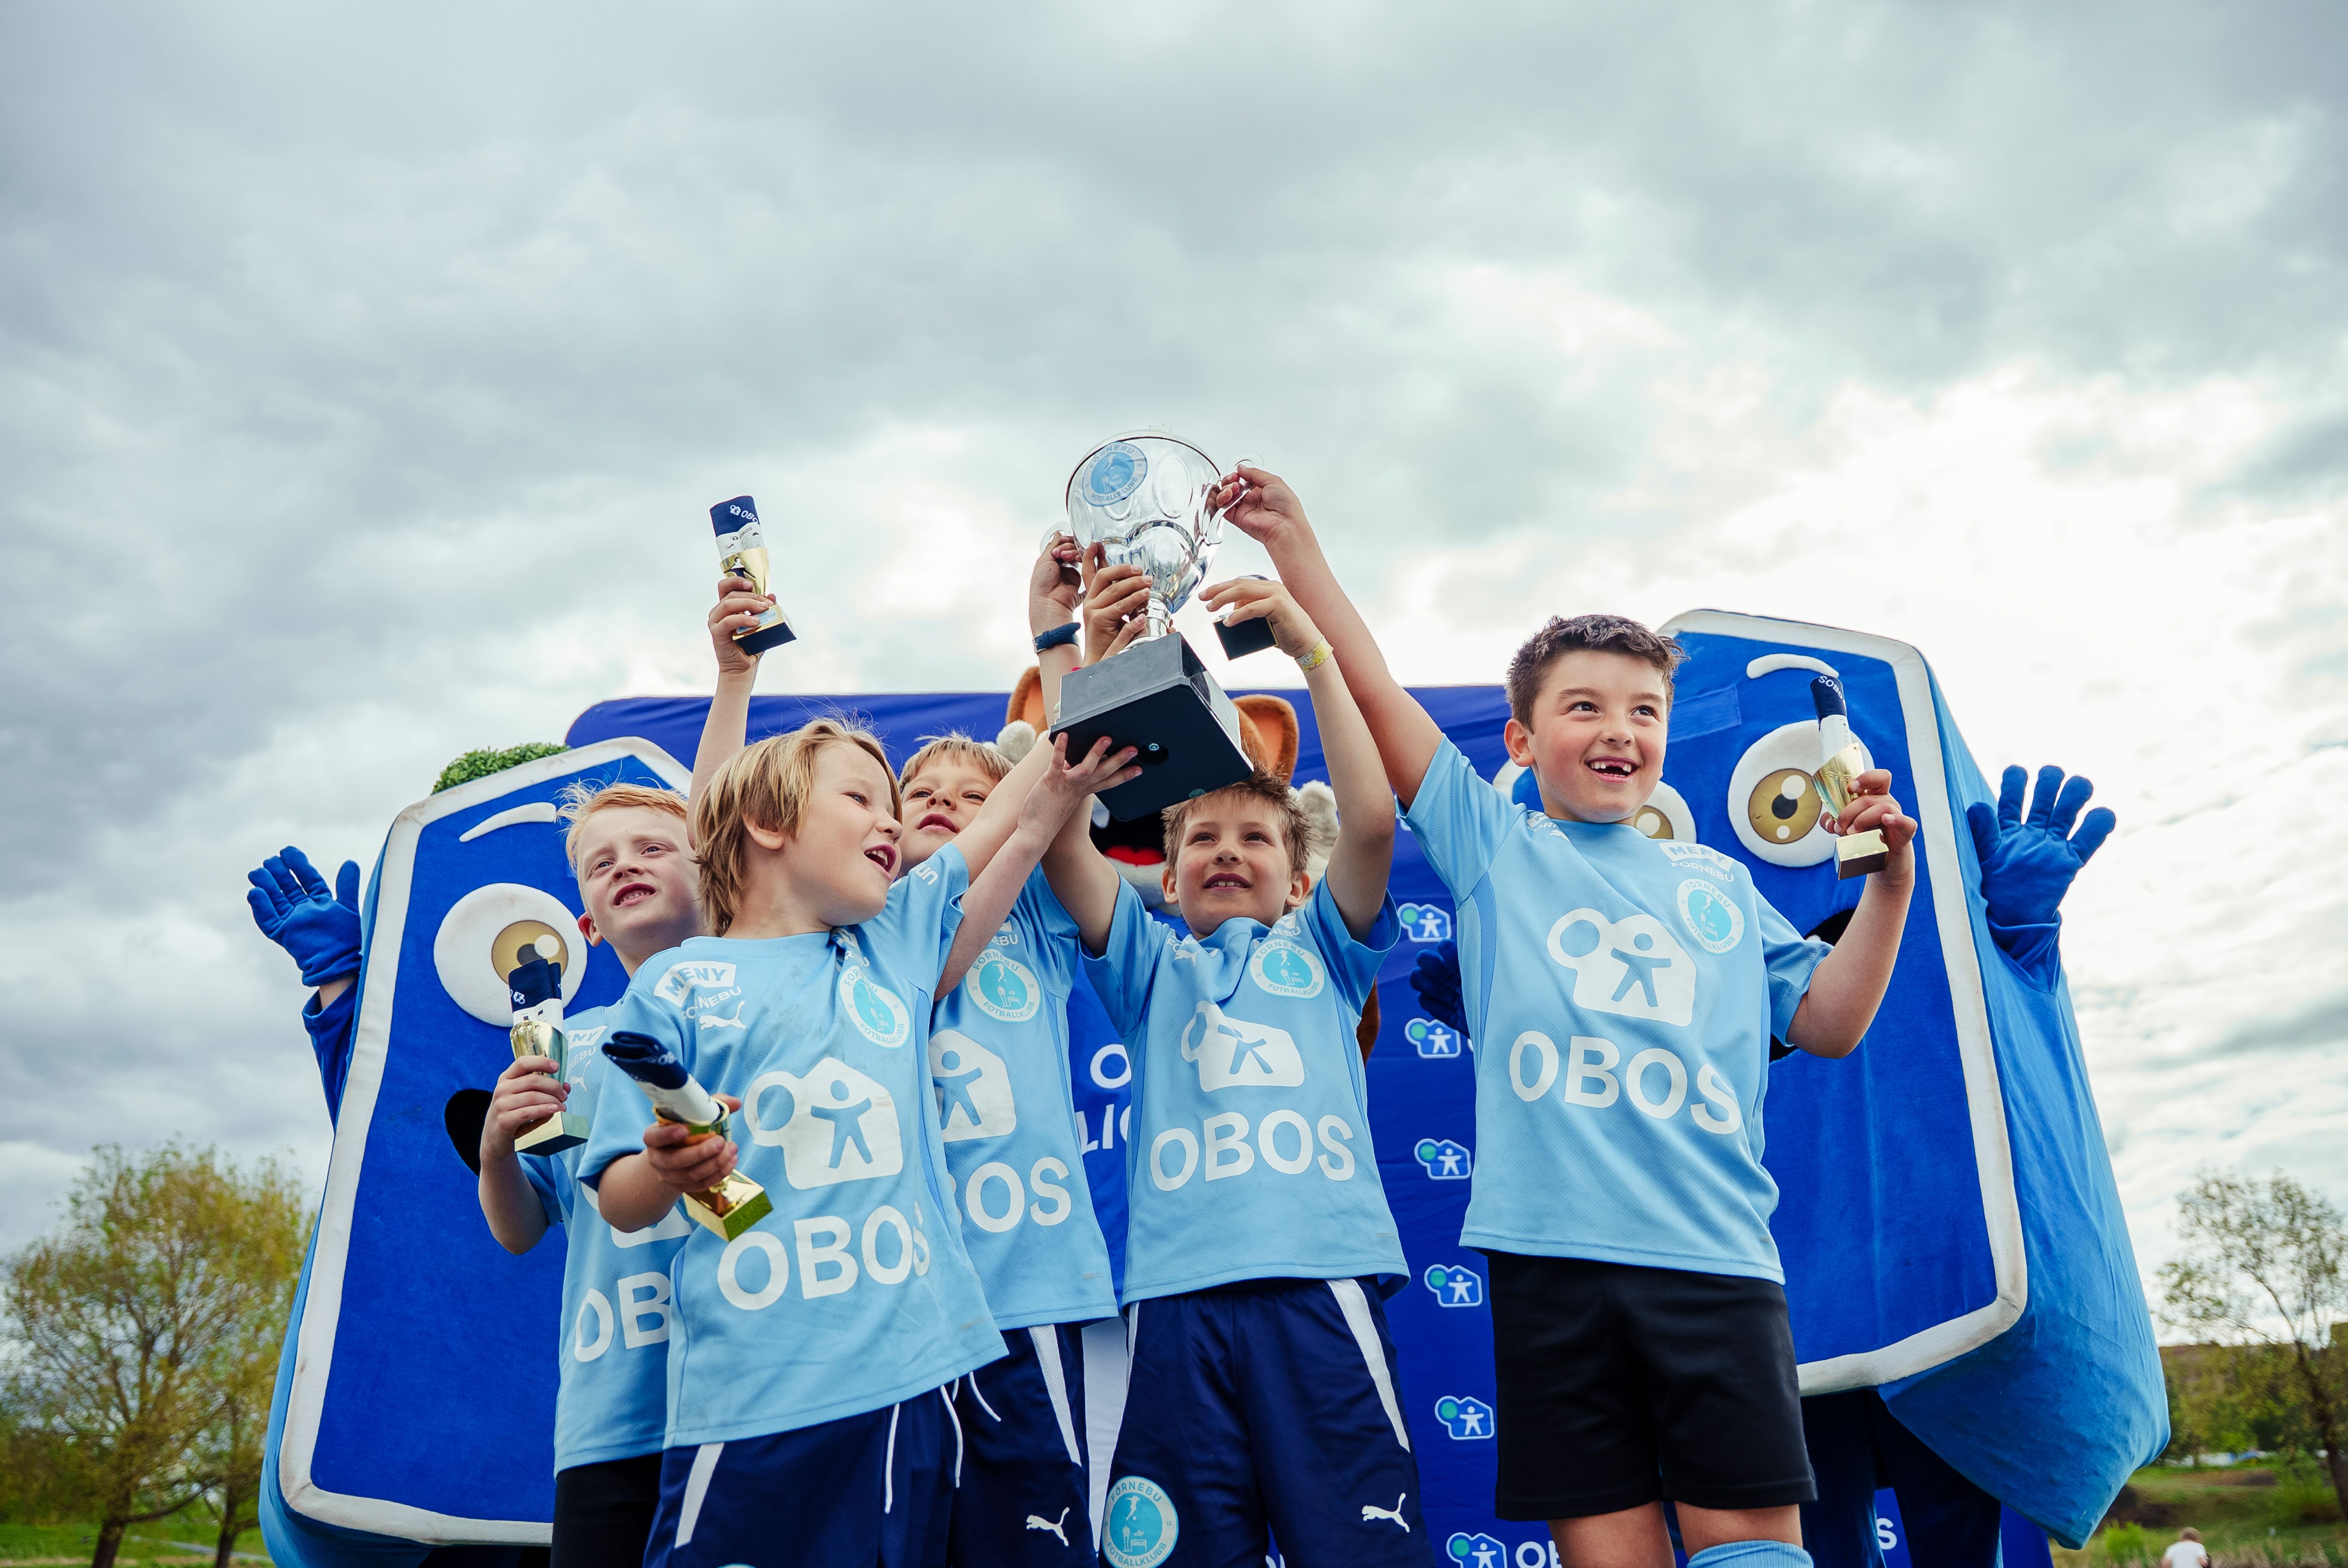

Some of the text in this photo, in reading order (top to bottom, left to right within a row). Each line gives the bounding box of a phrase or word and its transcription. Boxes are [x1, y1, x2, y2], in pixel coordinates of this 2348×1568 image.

[1089, 445, 1135, 469] FORNEBU
[1091, 477, 1138, 502] FOTBALLKLUBB
[741, 510, 759, 524] OBO
[1818, 676, 1843, 699] OBOS
[1668, 846, 1727, 863] MENY
[1670, 861, 1734, 883] FORNEBU
[1685, 881, 1731, 908] FORNEBU
[1269, 926, 1301, 937] NEBU
[1687, 918, 1735, 950] FOTBALLKLUBB
[1256, 941, 1305, 960] FORNEBU
[664, 967, 727, 997] MENY
[1268, 981, 1320, 996] FOTBALLKLUBB
[681, 986, 742, 1023] FONEBU
[983, 1001, 1035, 1018] FOTBALLKLUBB
[567, 1031, 599, 1046] NY
[1509, 1030, 1741, 1135] OBOS
[1150, 1109, 1355, 1191] OBOS
[948, 1156, 1072, 1233] OS
[717, 1201, 931, 1311] OBOS
[574, 1271, 671, 1362] OB
[1111, 1481, 1162, 1502] FORNEBU
[1107, 1542, 1166, 1566] FOTBALLKLUBB
